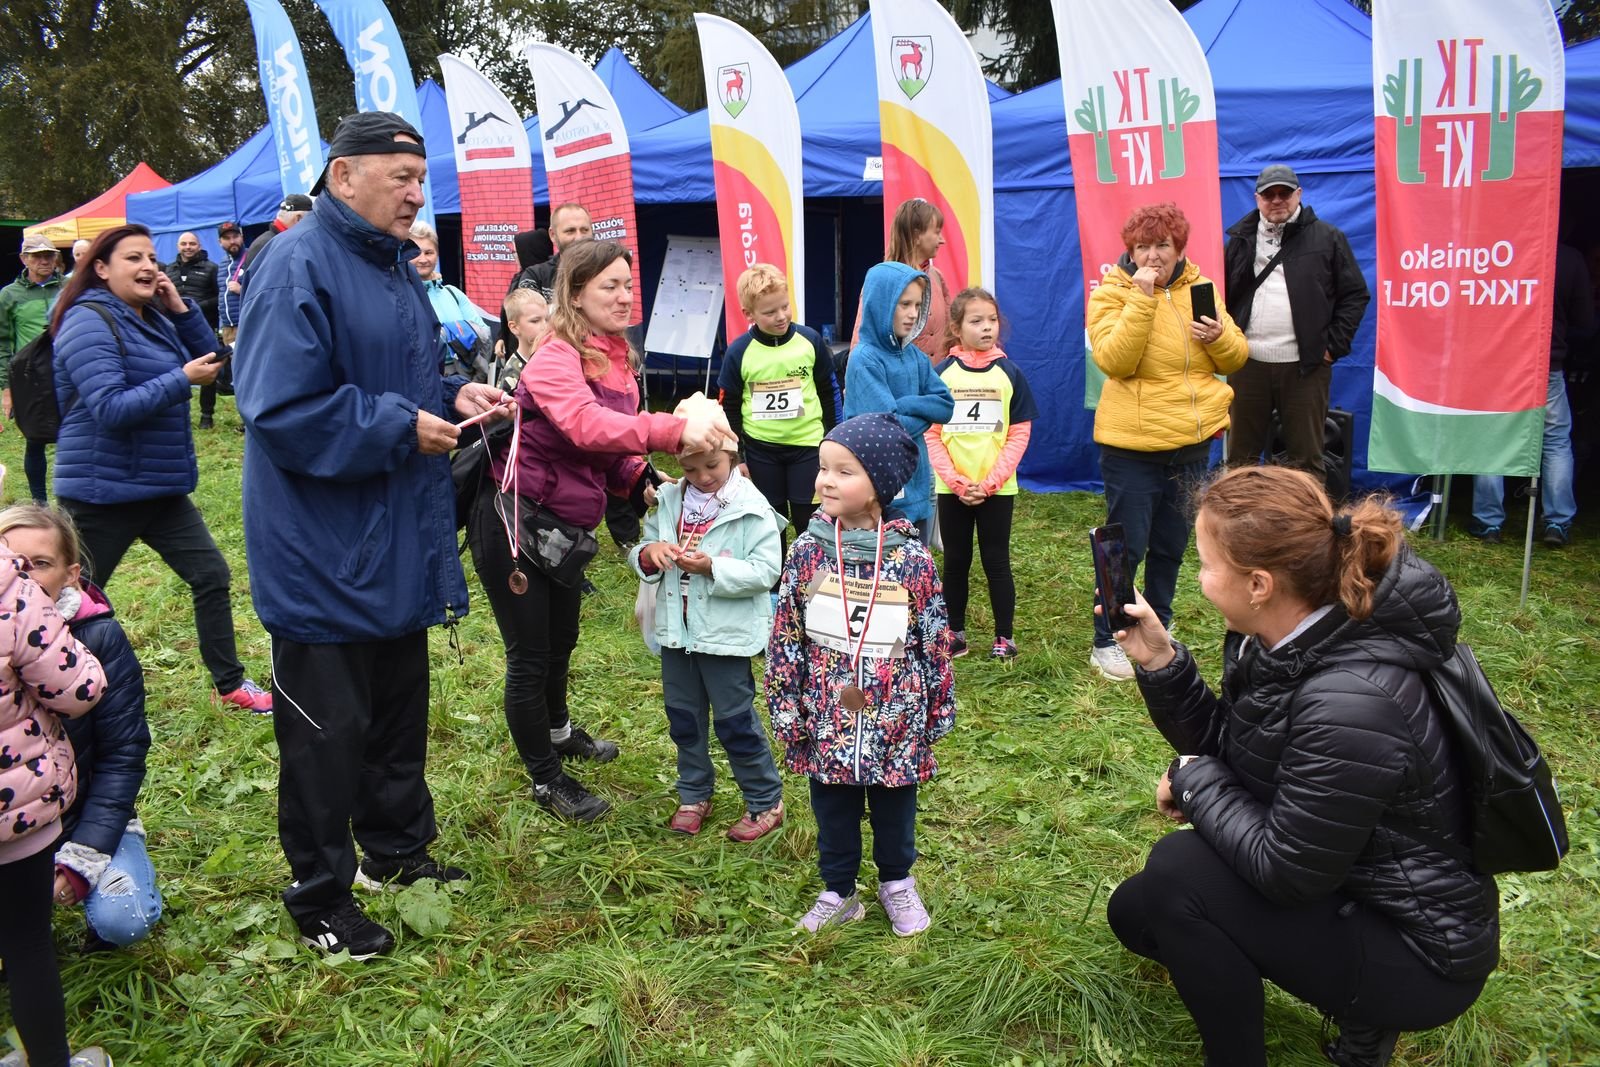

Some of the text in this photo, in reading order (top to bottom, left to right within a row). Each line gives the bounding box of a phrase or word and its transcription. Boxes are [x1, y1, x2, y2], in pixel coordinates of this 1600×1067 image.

[765, 392, 789, 411] 25
[967, 402, 980, 421] 4
[849, 605, 869, 638] 5
